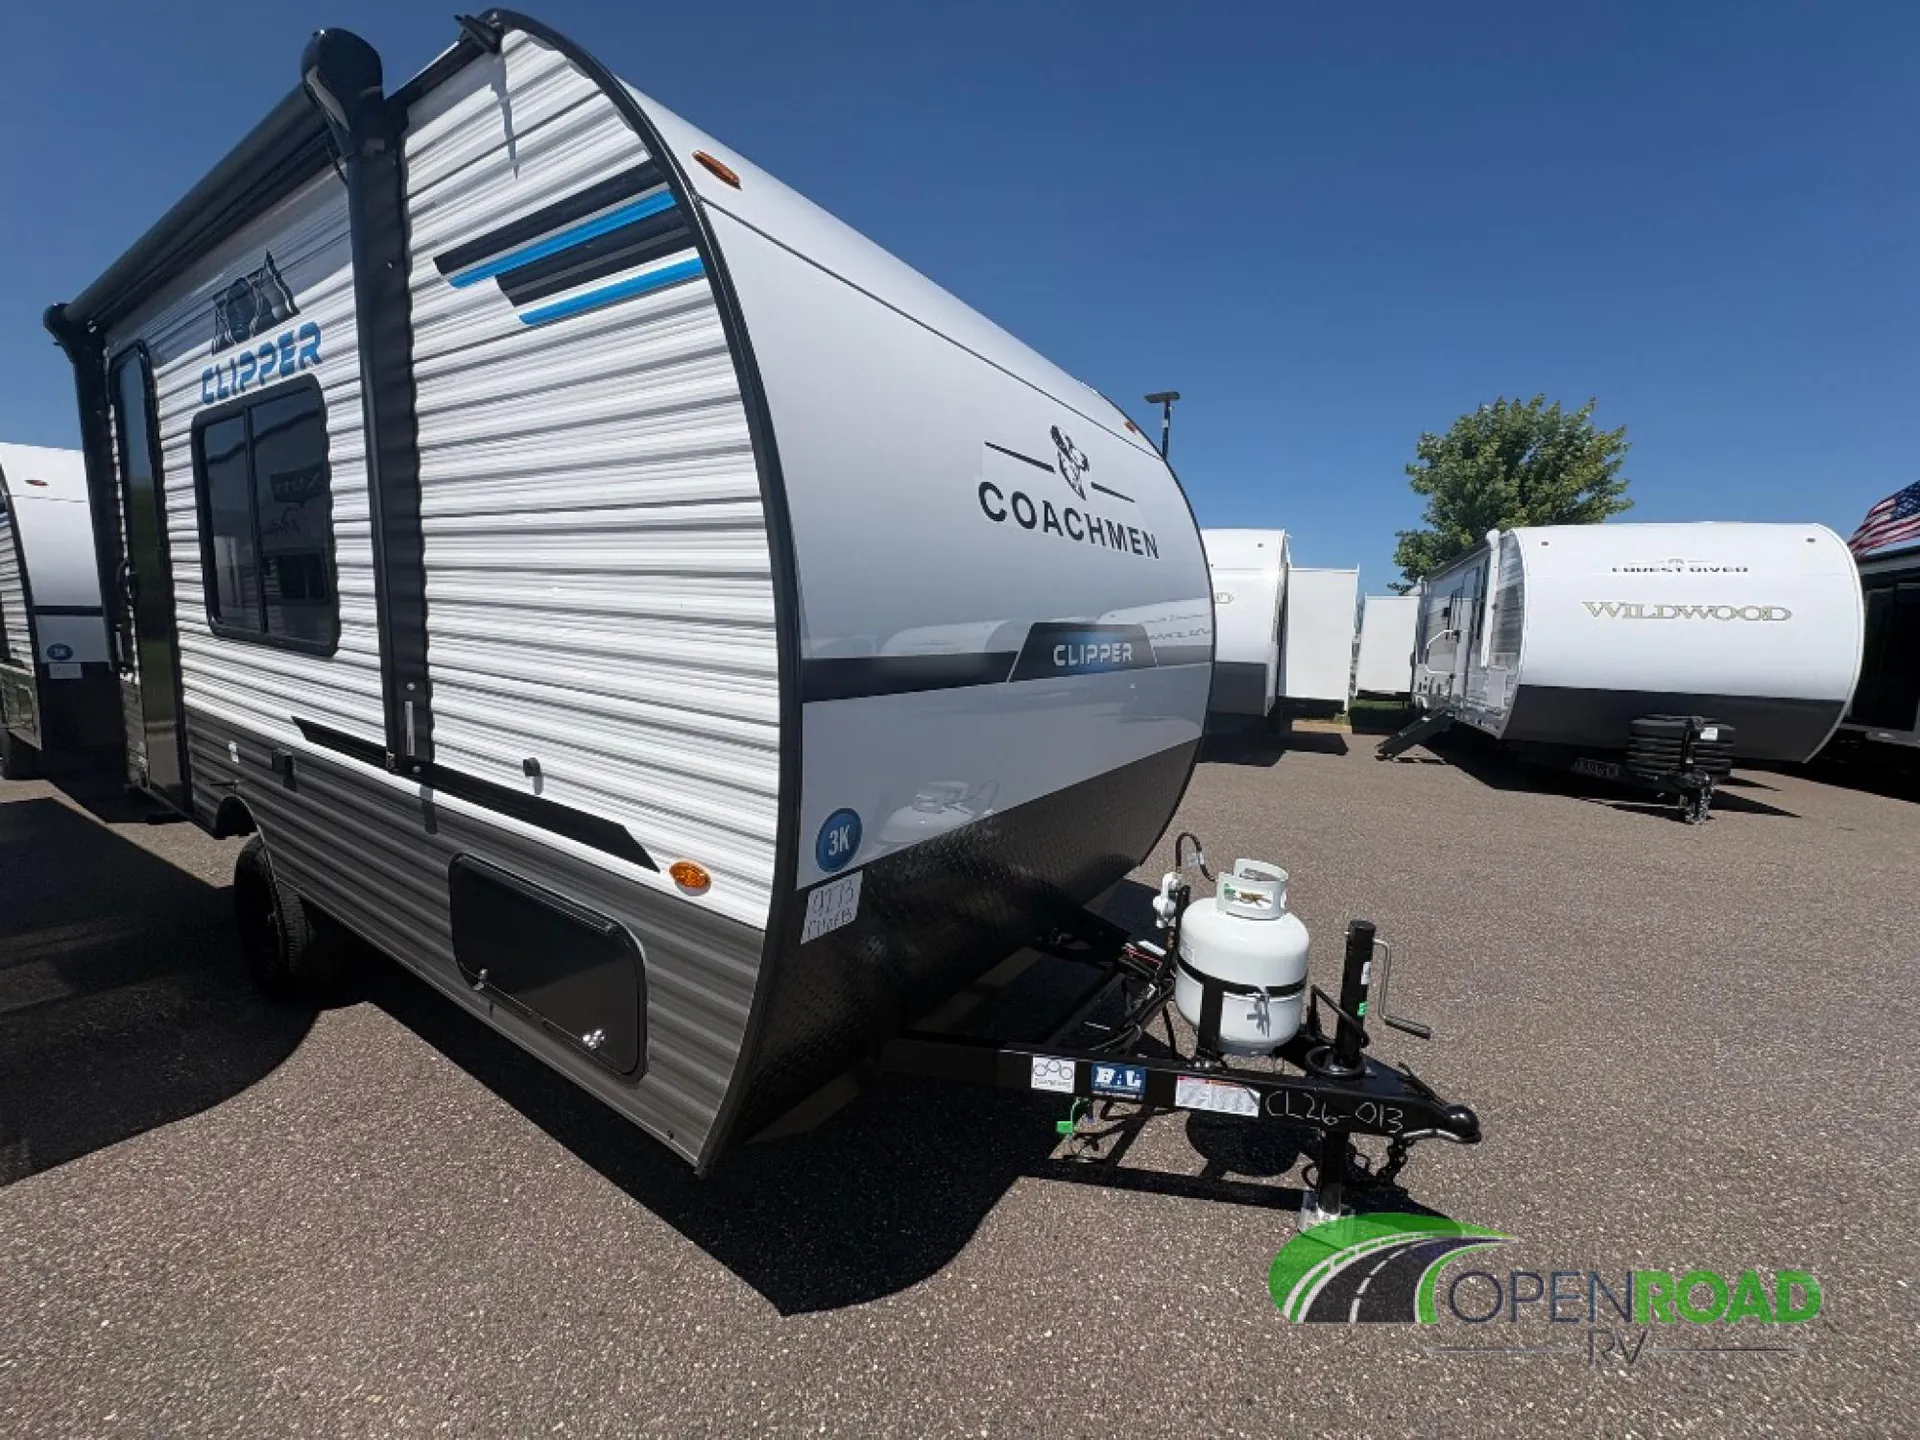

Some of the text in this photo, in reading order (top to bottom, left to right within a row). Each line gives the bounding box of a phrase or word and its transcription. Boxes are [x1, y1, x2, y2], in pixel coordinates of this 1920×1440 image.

[202, 321, 323, 404] CLIPPER
[978, 481, 1159, 559] COACHMEN
[1582, 601, 1792, 621] WILDWOOD
[1053, 642, 1133, 667] CLIPPER
[828, 824, 850, 856] 3K
[1265, 1090, 1403, 1133] CL26-013
